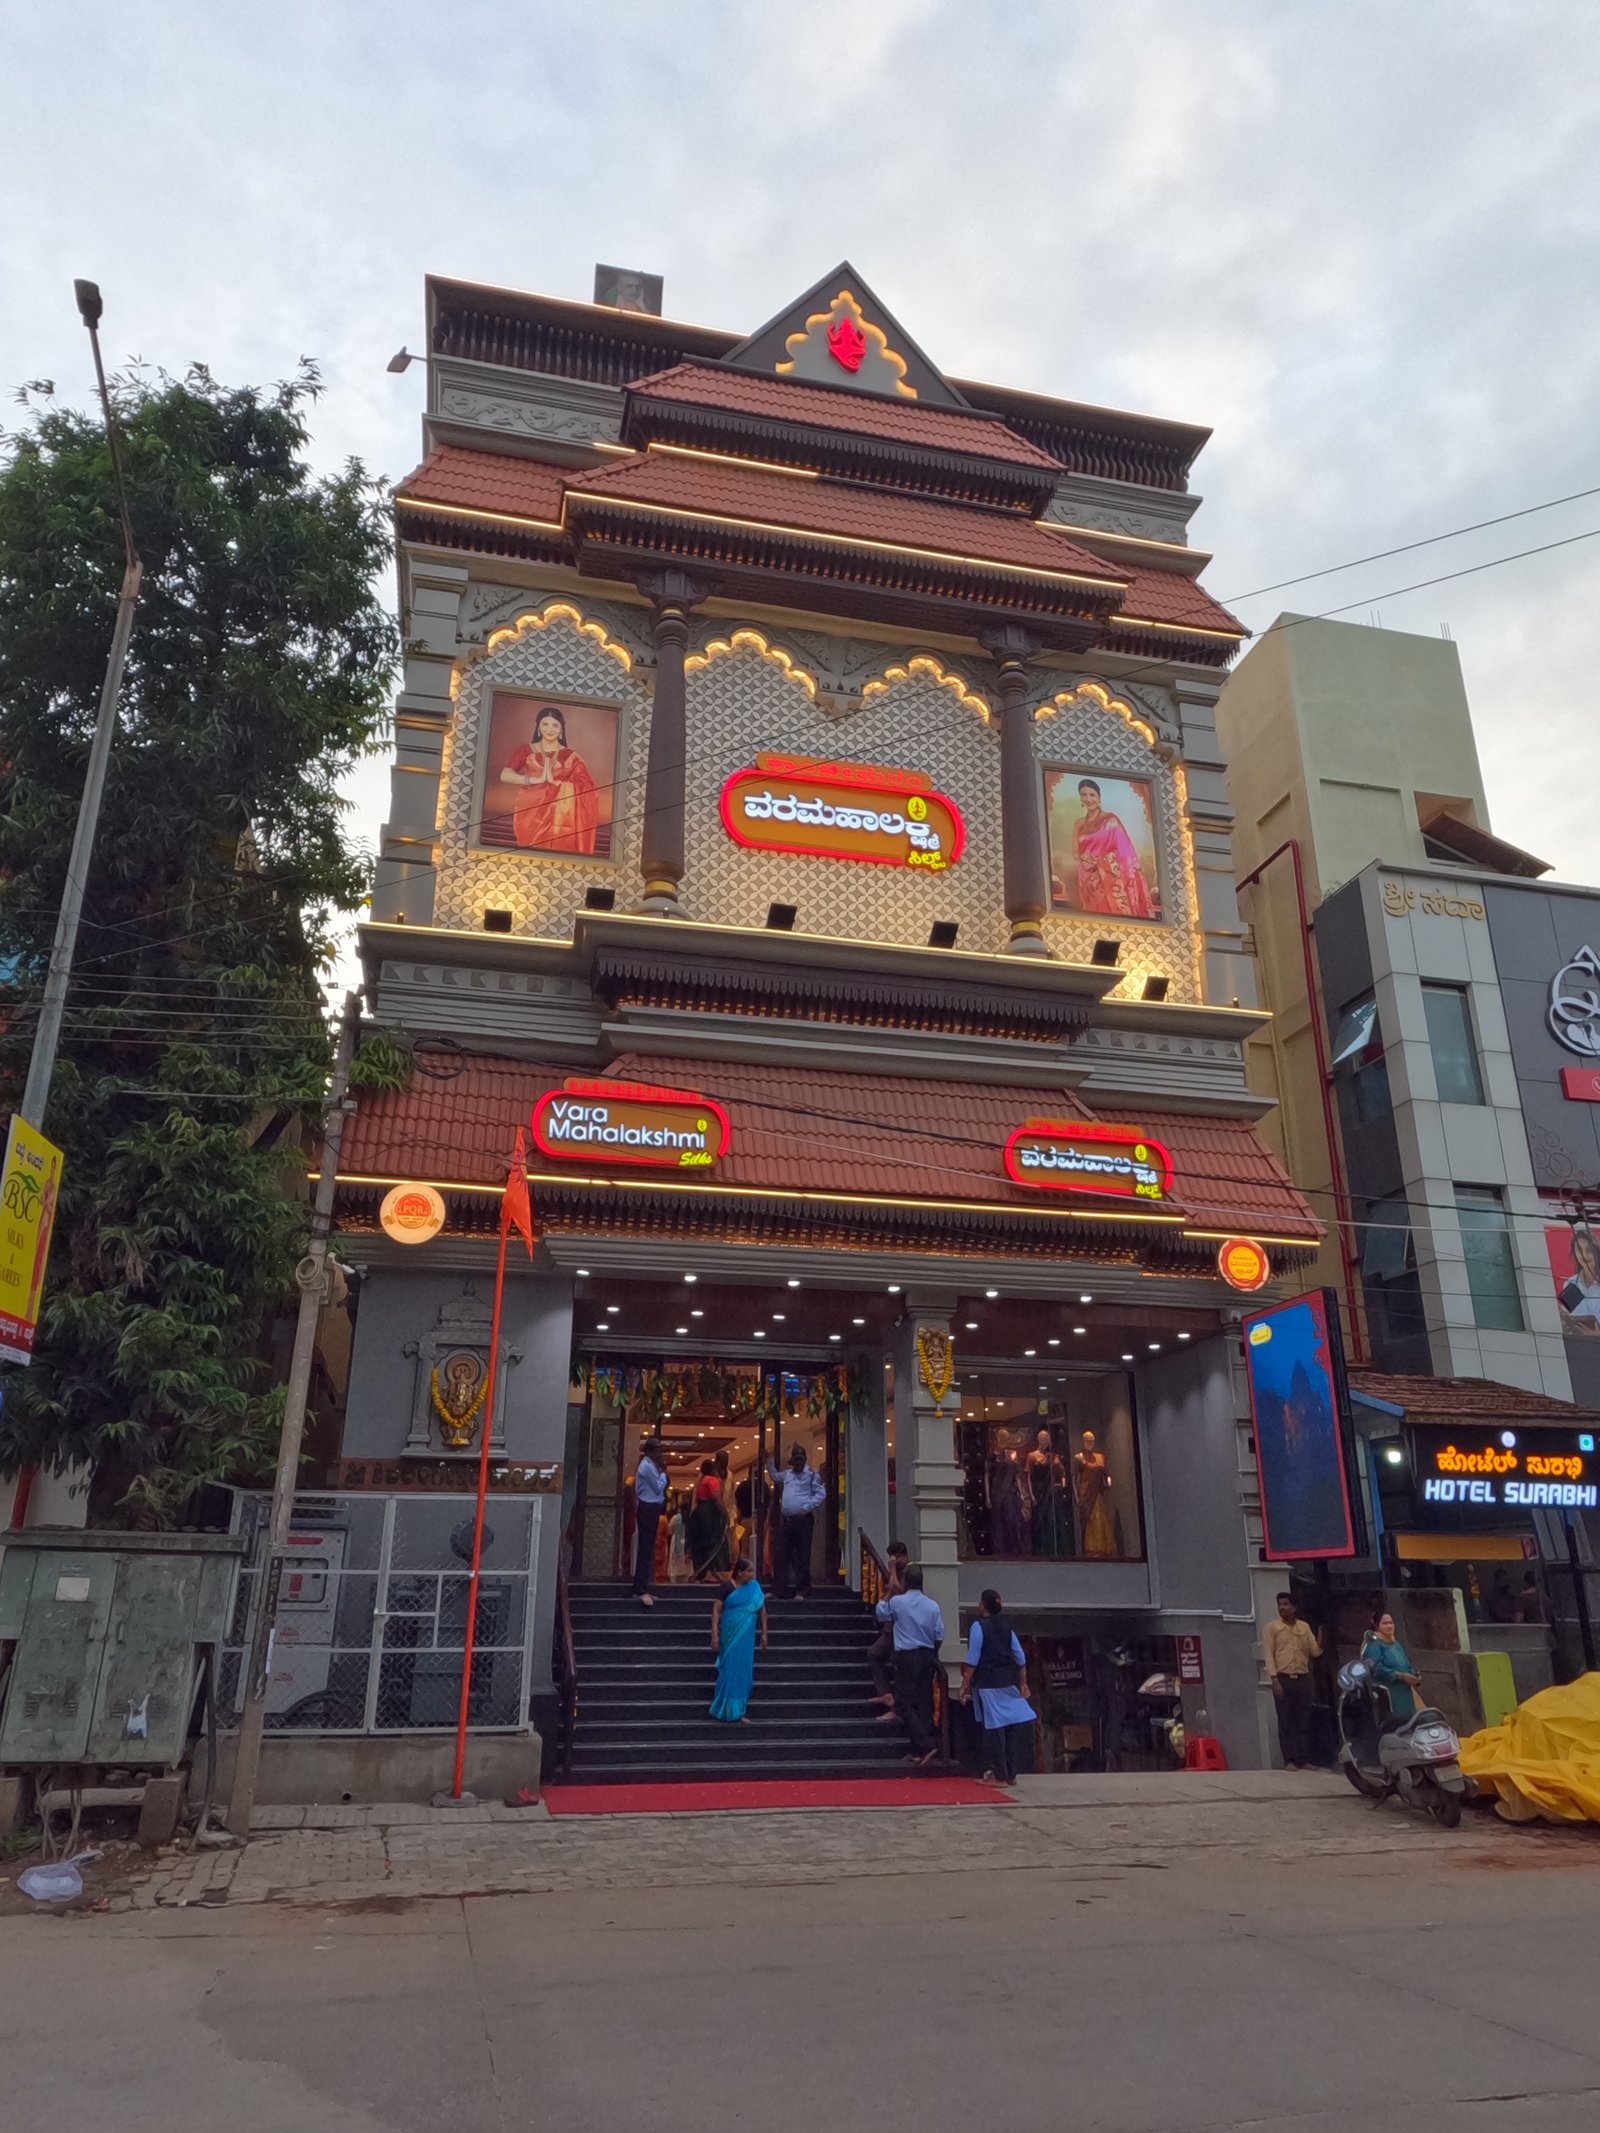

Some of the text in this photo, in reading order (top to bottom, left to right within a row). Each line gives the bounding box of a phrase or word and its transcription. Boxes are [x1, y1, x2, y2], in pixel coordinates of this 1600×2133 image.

[551, 1101, 608, 1123] Vara
[549, 1118, 707, 1149] Mahalakshmi
[678, 1151, 713, 1166] Silks
[4, 1178, 40, 1223] BSC
[1436, 1445, 1583, 1480] ಹೋಟೆಲ್ ಸುರಭಿ
[1425, 1479, 1597, 1507] HOTEL SURABHI
